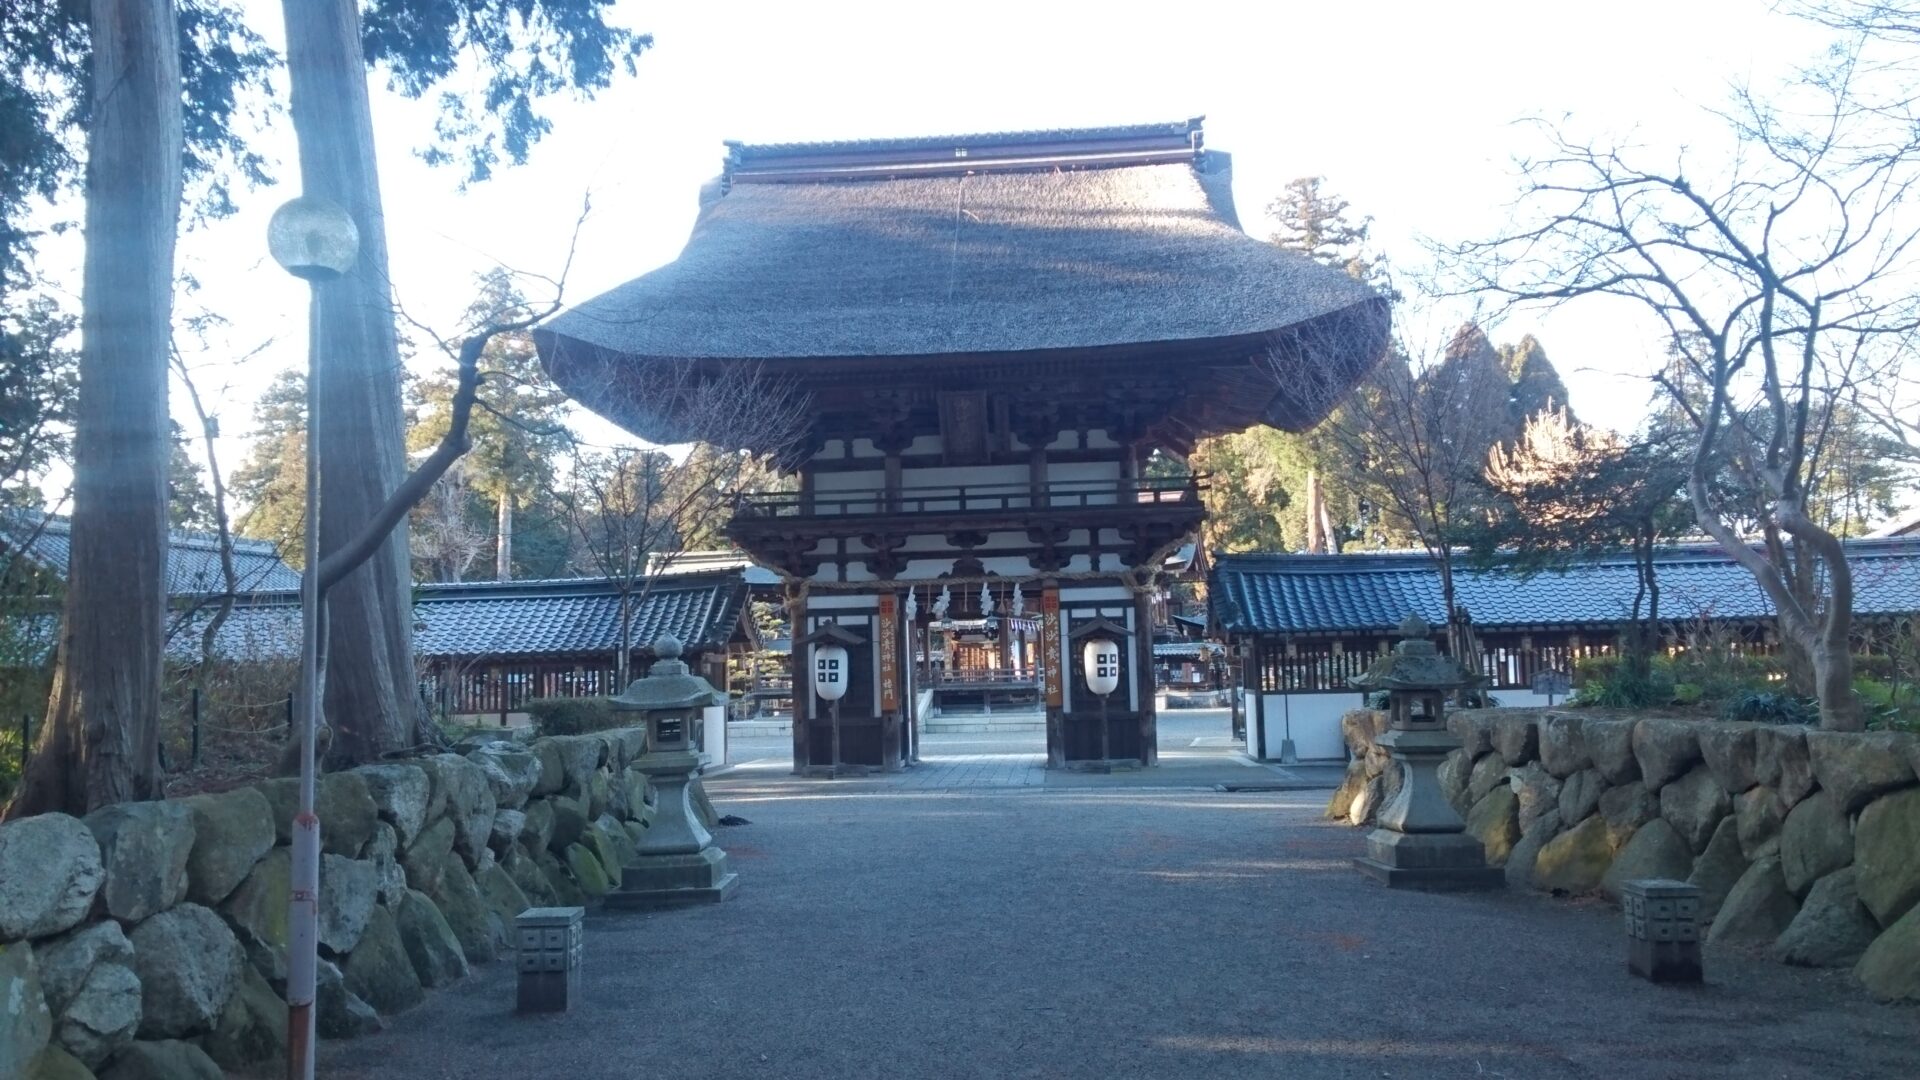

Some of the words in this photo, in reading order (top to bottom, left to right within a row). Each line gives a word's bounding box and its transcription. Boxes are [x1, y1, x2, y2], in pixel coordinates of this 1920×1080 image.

[1045, 613, 1058, 695] 沙沙貴神社
